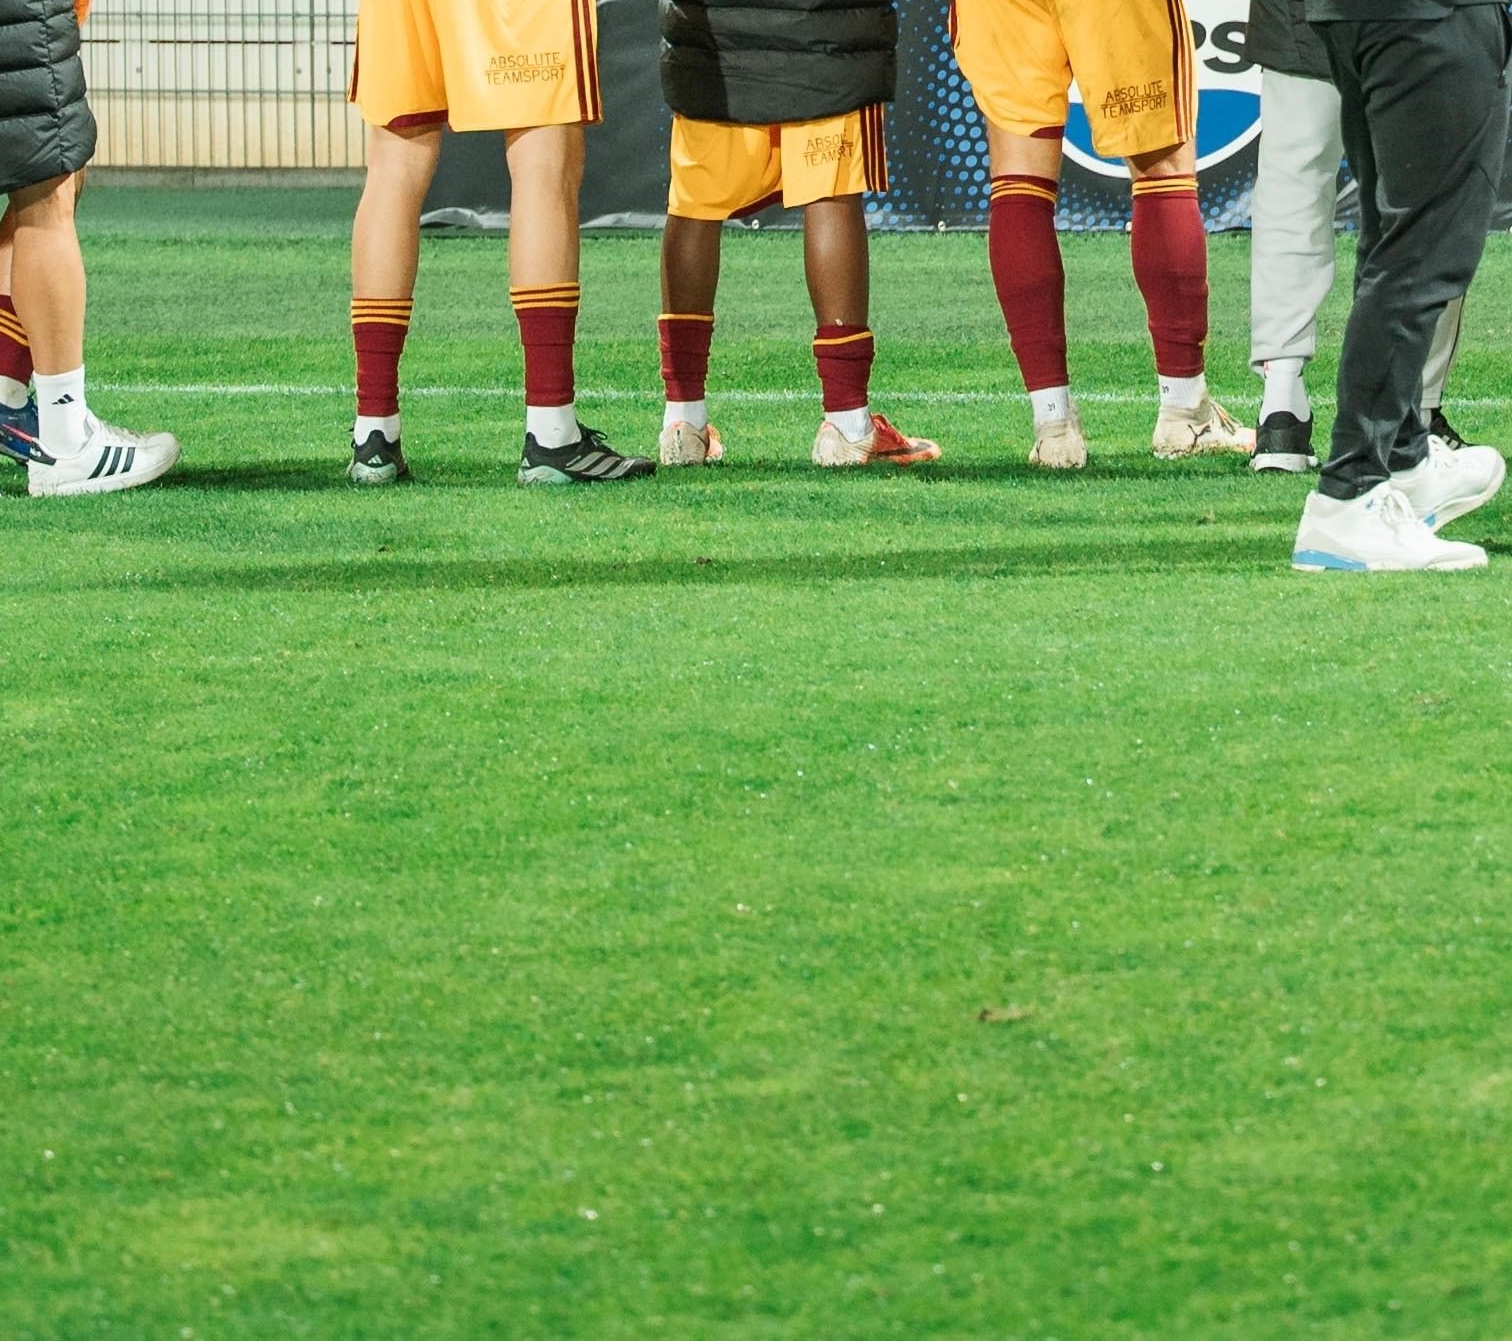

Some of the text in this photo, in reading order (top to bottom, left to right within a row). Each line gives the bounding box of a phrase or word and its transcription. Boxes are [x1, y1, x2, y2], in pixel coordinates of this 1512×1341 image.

[489, 51, 561, 70] ABSOLUTE
[485, 67, 566, 85] TEAMSPORT
[1104, 80, 1164, 104] ABSOLUTE
[1100, 93, 1168, 119] TEAMSPORT
